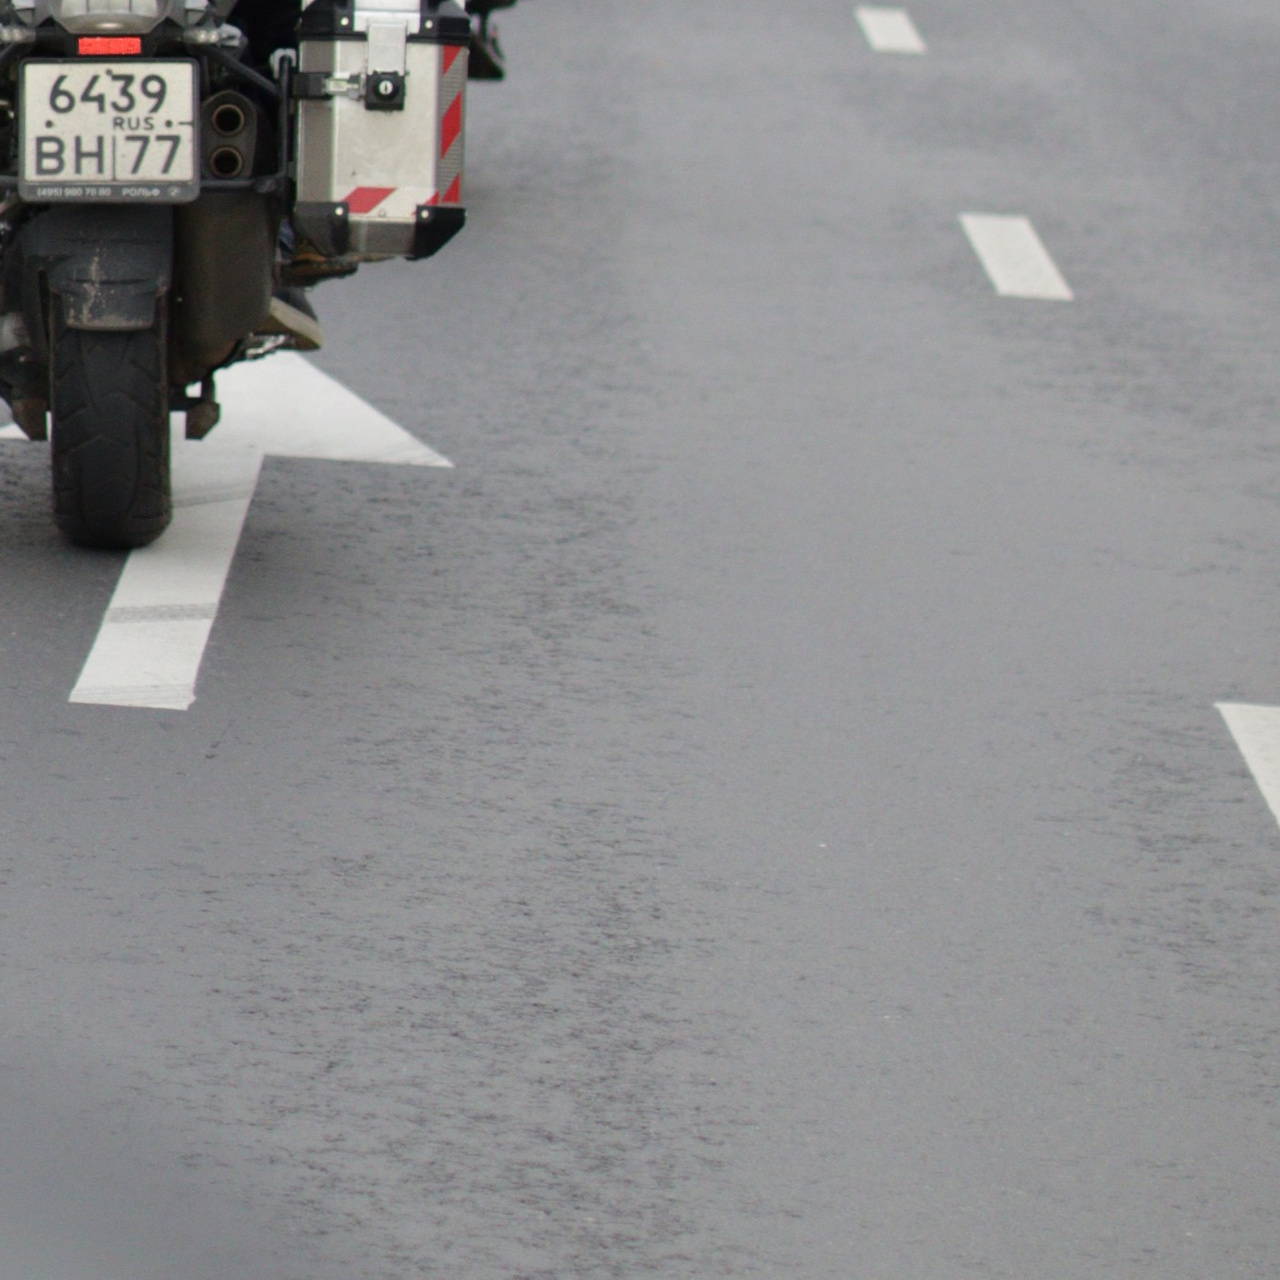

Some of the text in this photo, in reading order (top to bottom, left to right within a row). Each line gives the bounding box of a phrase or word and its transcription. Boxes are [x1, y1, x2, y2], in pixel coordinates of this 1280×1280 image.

[49, 74, 167, 114] 6439
[113, 117, 155, 130] RUS
[124, 134, 181, 174] 77
